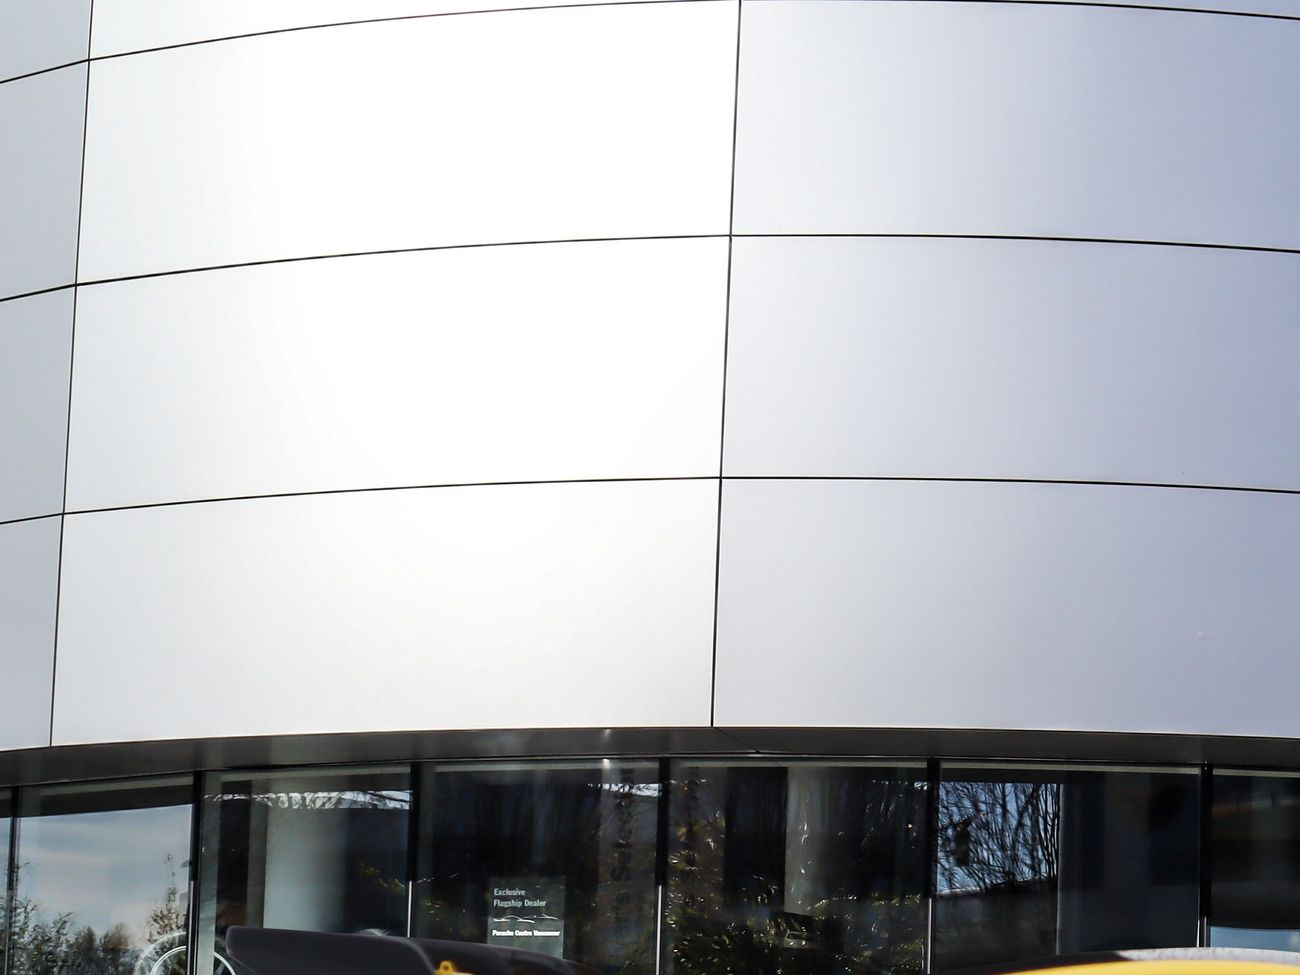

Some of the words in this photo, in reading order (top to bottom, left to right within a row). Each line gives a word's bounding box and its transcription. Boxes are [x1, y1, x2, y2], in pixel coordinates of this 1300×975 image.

[493, 888, 526, 896] Exclusive
[493, 899, 523, 908] Flagship
[524, 899, 547, 907] Dealer
